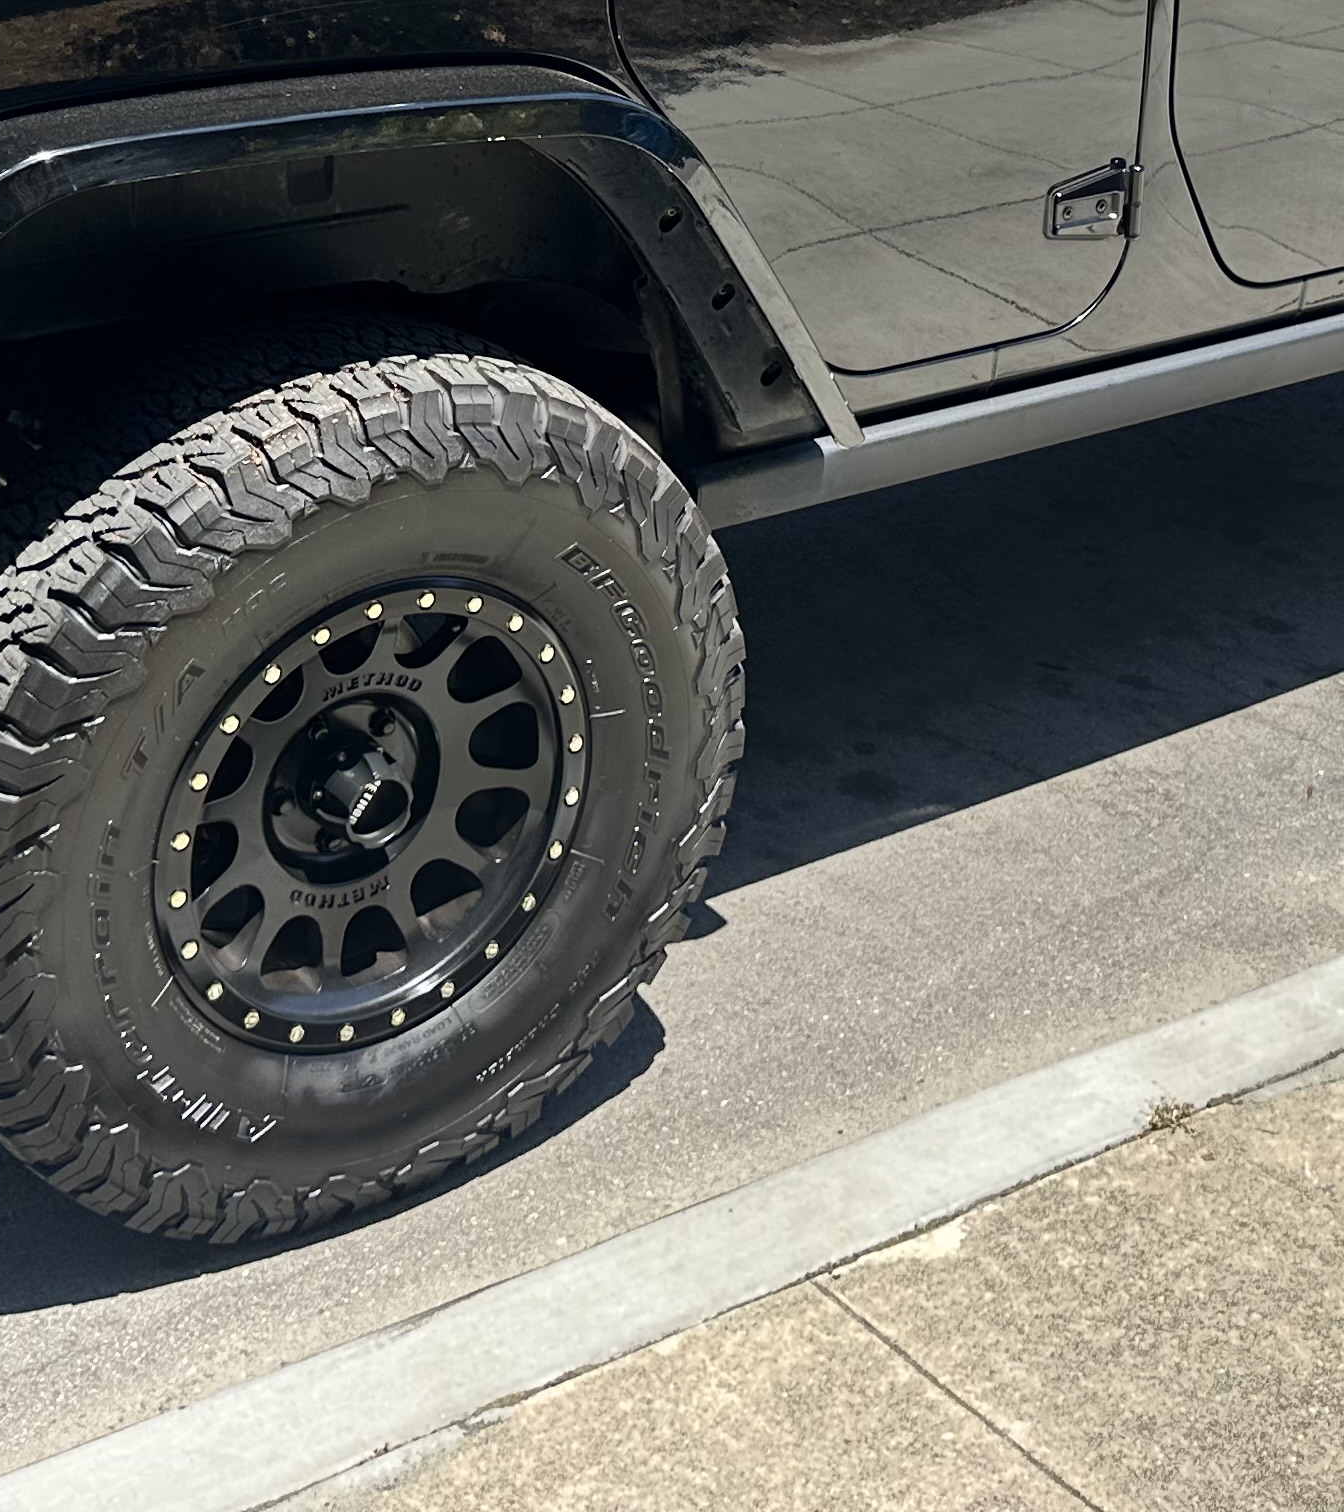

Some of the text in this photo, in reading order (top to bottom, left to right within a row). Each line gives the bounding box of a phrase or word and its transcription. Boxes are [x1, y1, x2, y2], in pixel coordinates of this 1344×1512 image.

[322, 671, 423, 703] METHOD
[555, 541, 671, 922] BFGoodrich
[289, 875, 391, 909] METHOD
